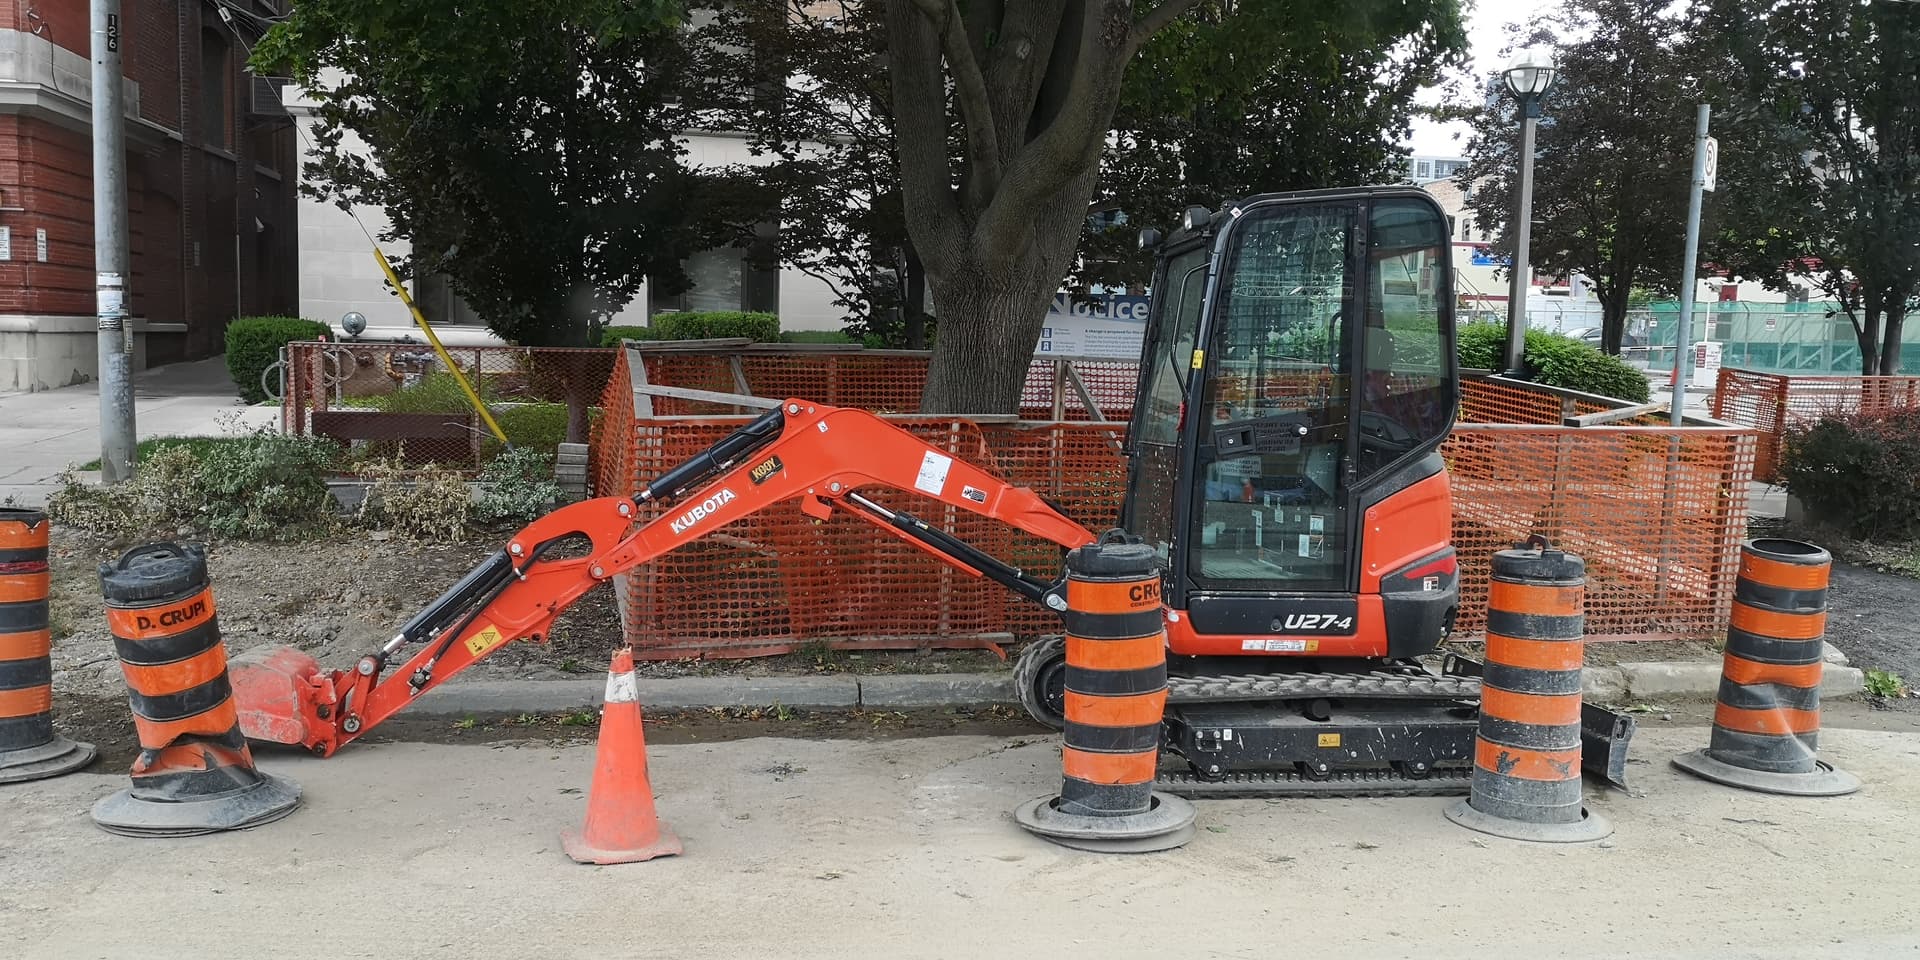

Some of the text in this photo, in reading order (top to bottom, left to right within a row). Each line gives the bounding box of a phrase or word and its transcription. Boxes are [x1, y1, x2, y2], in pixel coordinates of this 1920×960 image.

[108, 15, 117, 49] 126
[670, 488, 736, 534] KUBOTA
[136, 599, 206, 630] D. CRUPI
[1284, 614, 1353, 630] U27-4
